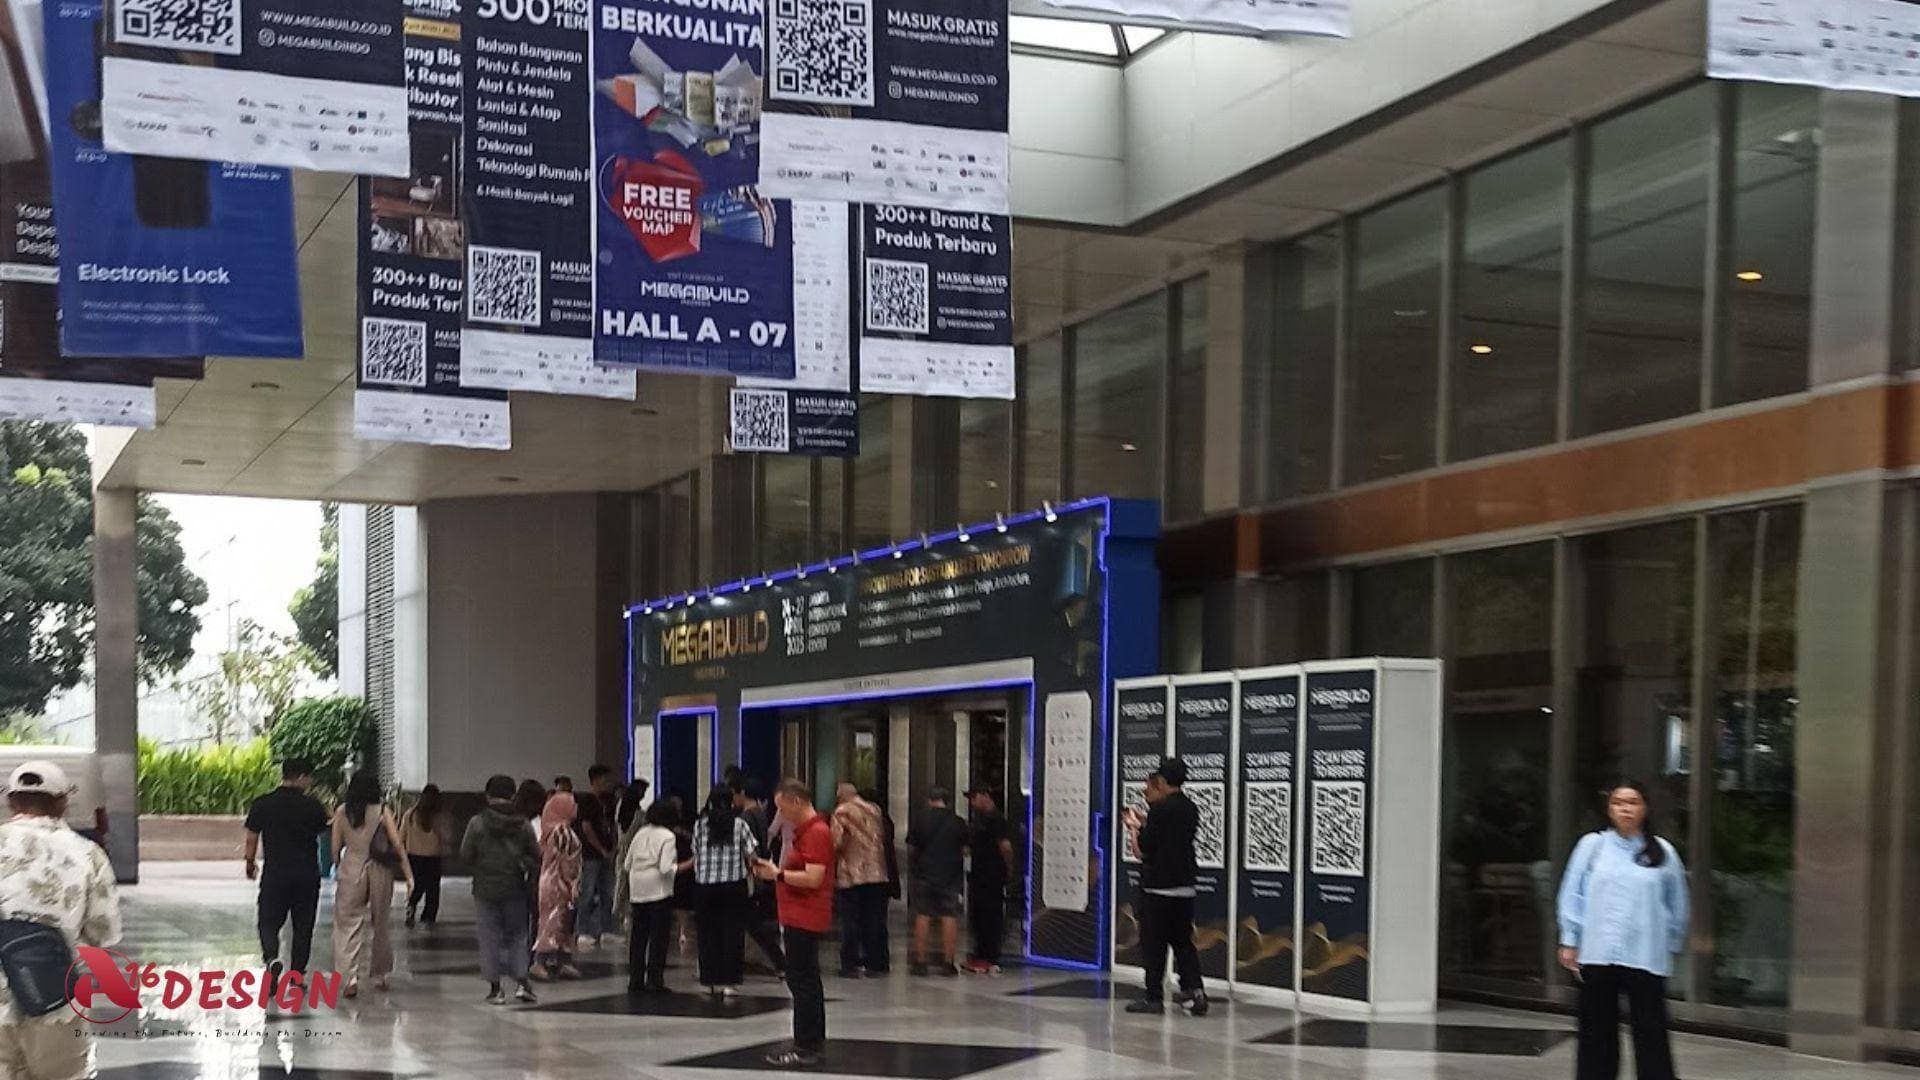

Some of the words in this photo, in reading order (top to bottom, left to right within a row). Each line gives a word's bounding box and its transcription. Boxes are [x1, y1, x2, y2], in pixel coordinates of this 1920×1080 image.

[887, 8, 942, 31] MASUK
[943, 16, 999, 37] GRATIS
[476, 36, 517, 55] Bahan
[520, 42, 582, 63] Bangunan
[476, 56, 509, 74] Pintu
[511, 61, 520, 76] &
[522, 63, 571, 81] Jendela
[476, 77, 503, 93] Alat
[506, 80, 515, 95] &
[517, 83, 554, 100] Mesin
[476, 96, 517, 115] Lantai
[519, 102, 529, 116] &
[531, 104, 562, 122] Atap
[476, 116, 527, 136] Sanitasi
[476, 136, 533, 157] Dekorasi
[476, 157, 537, 179] Teknologi
[539, 163, 582, 182] Rumah
[623, 182, 692, 210] FREE
[622, 205, 693, 226] VOUCHER
[642, 220, 674, 236] MAP
[874, 203, 928, 224] 300++
[930, 209, 979, 231] Brand
[981, 215, 994, 233] &
[875, 227, 932, 250] Produk
[934, 232, 998, 256] Terbaru
[77, 263, 180, 284] Electronic
[181, 266, 231, 285] Lock
[372, 266, 426, 288] 300++
[372, 288, 430, 311] Produk
[641, 280, 750, 304] MEGABUILD
[602, 309, 688, 341] HALL
[696, 317, 721, 343] A
[750, 320, 788, 348] 07
[660, 610, 770, 666] MEGABUILD
